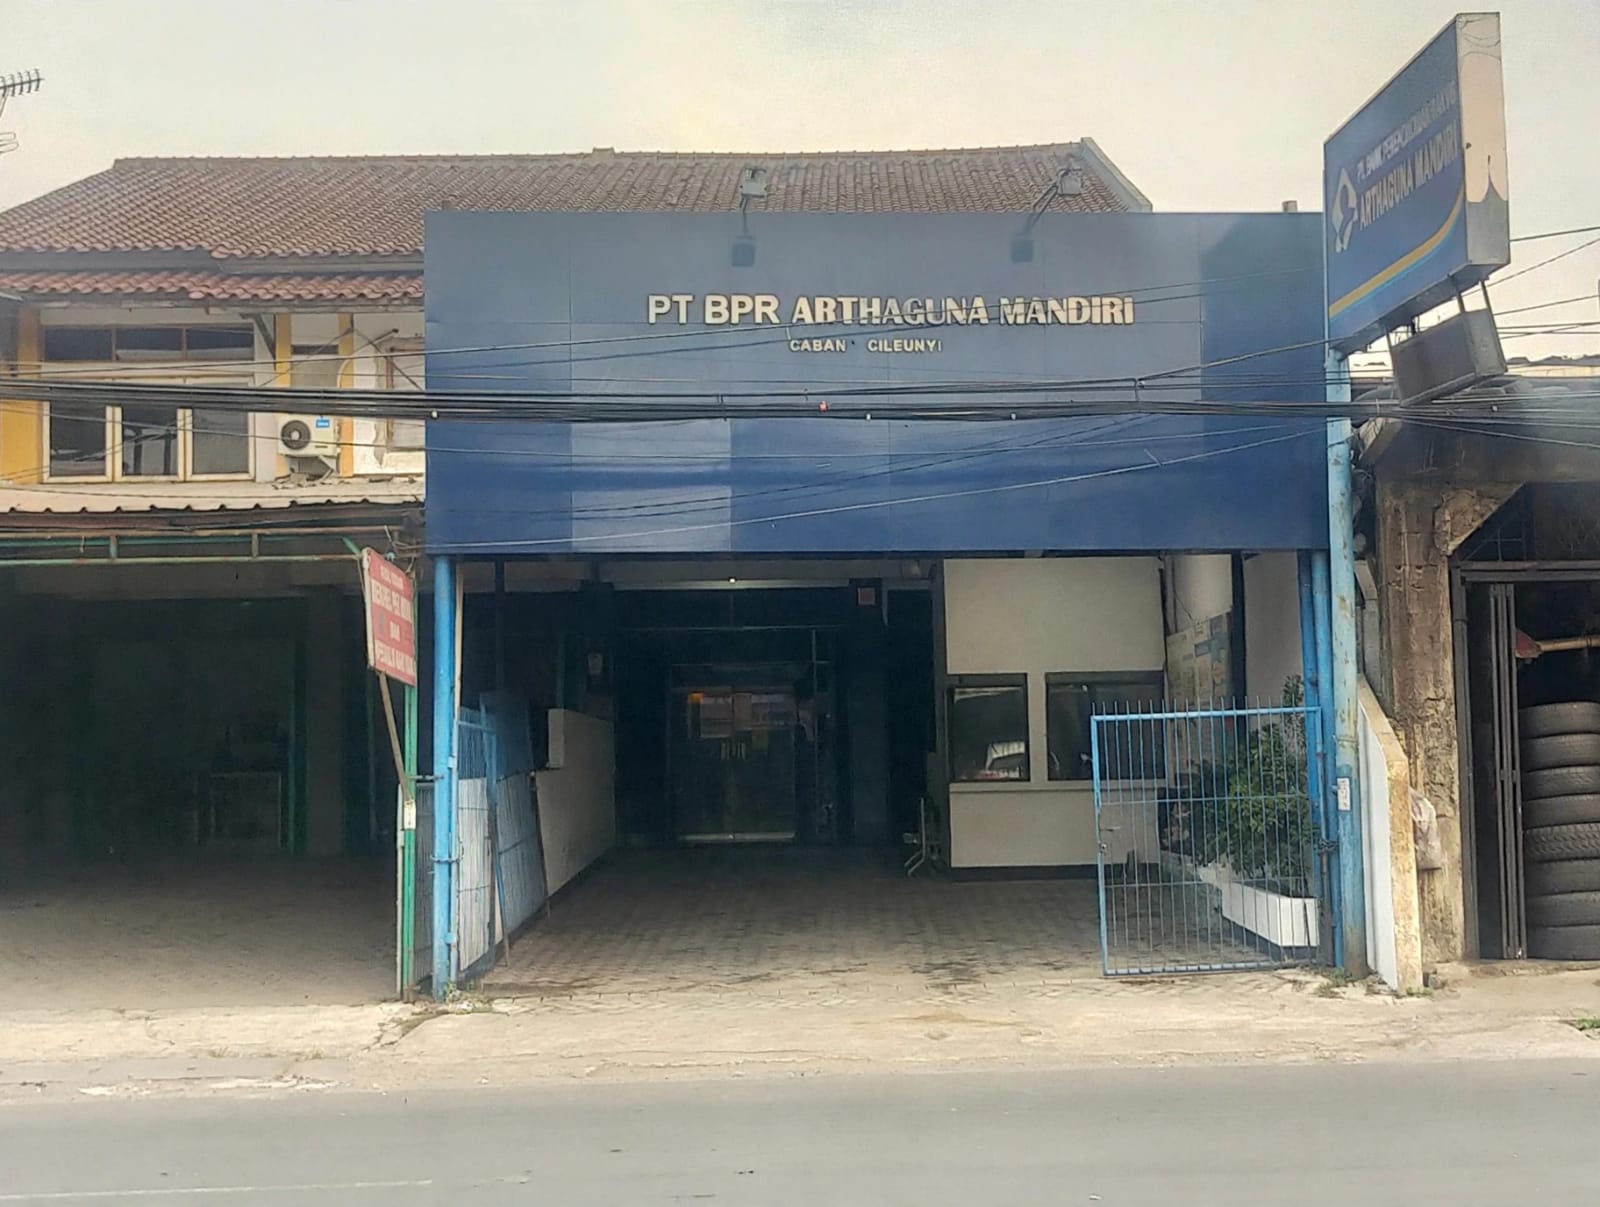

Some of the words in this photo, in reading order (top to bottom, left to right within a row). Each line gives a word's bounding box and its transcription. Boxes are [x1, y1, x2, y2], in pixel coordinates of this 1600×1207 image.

[1359, 157, 1414, 232] ARTHAGUNA
[1414, 119, 1459, 189] MANDIRI
[648, 295, 694, 325] PT
[704, 294, 781, 325] BPR
[791, 296, 989, 325] ARTHAGUNA
[999, 296, 1135, 325] MANDIRI
[866, 339, 942, 353] CILEUNYI
